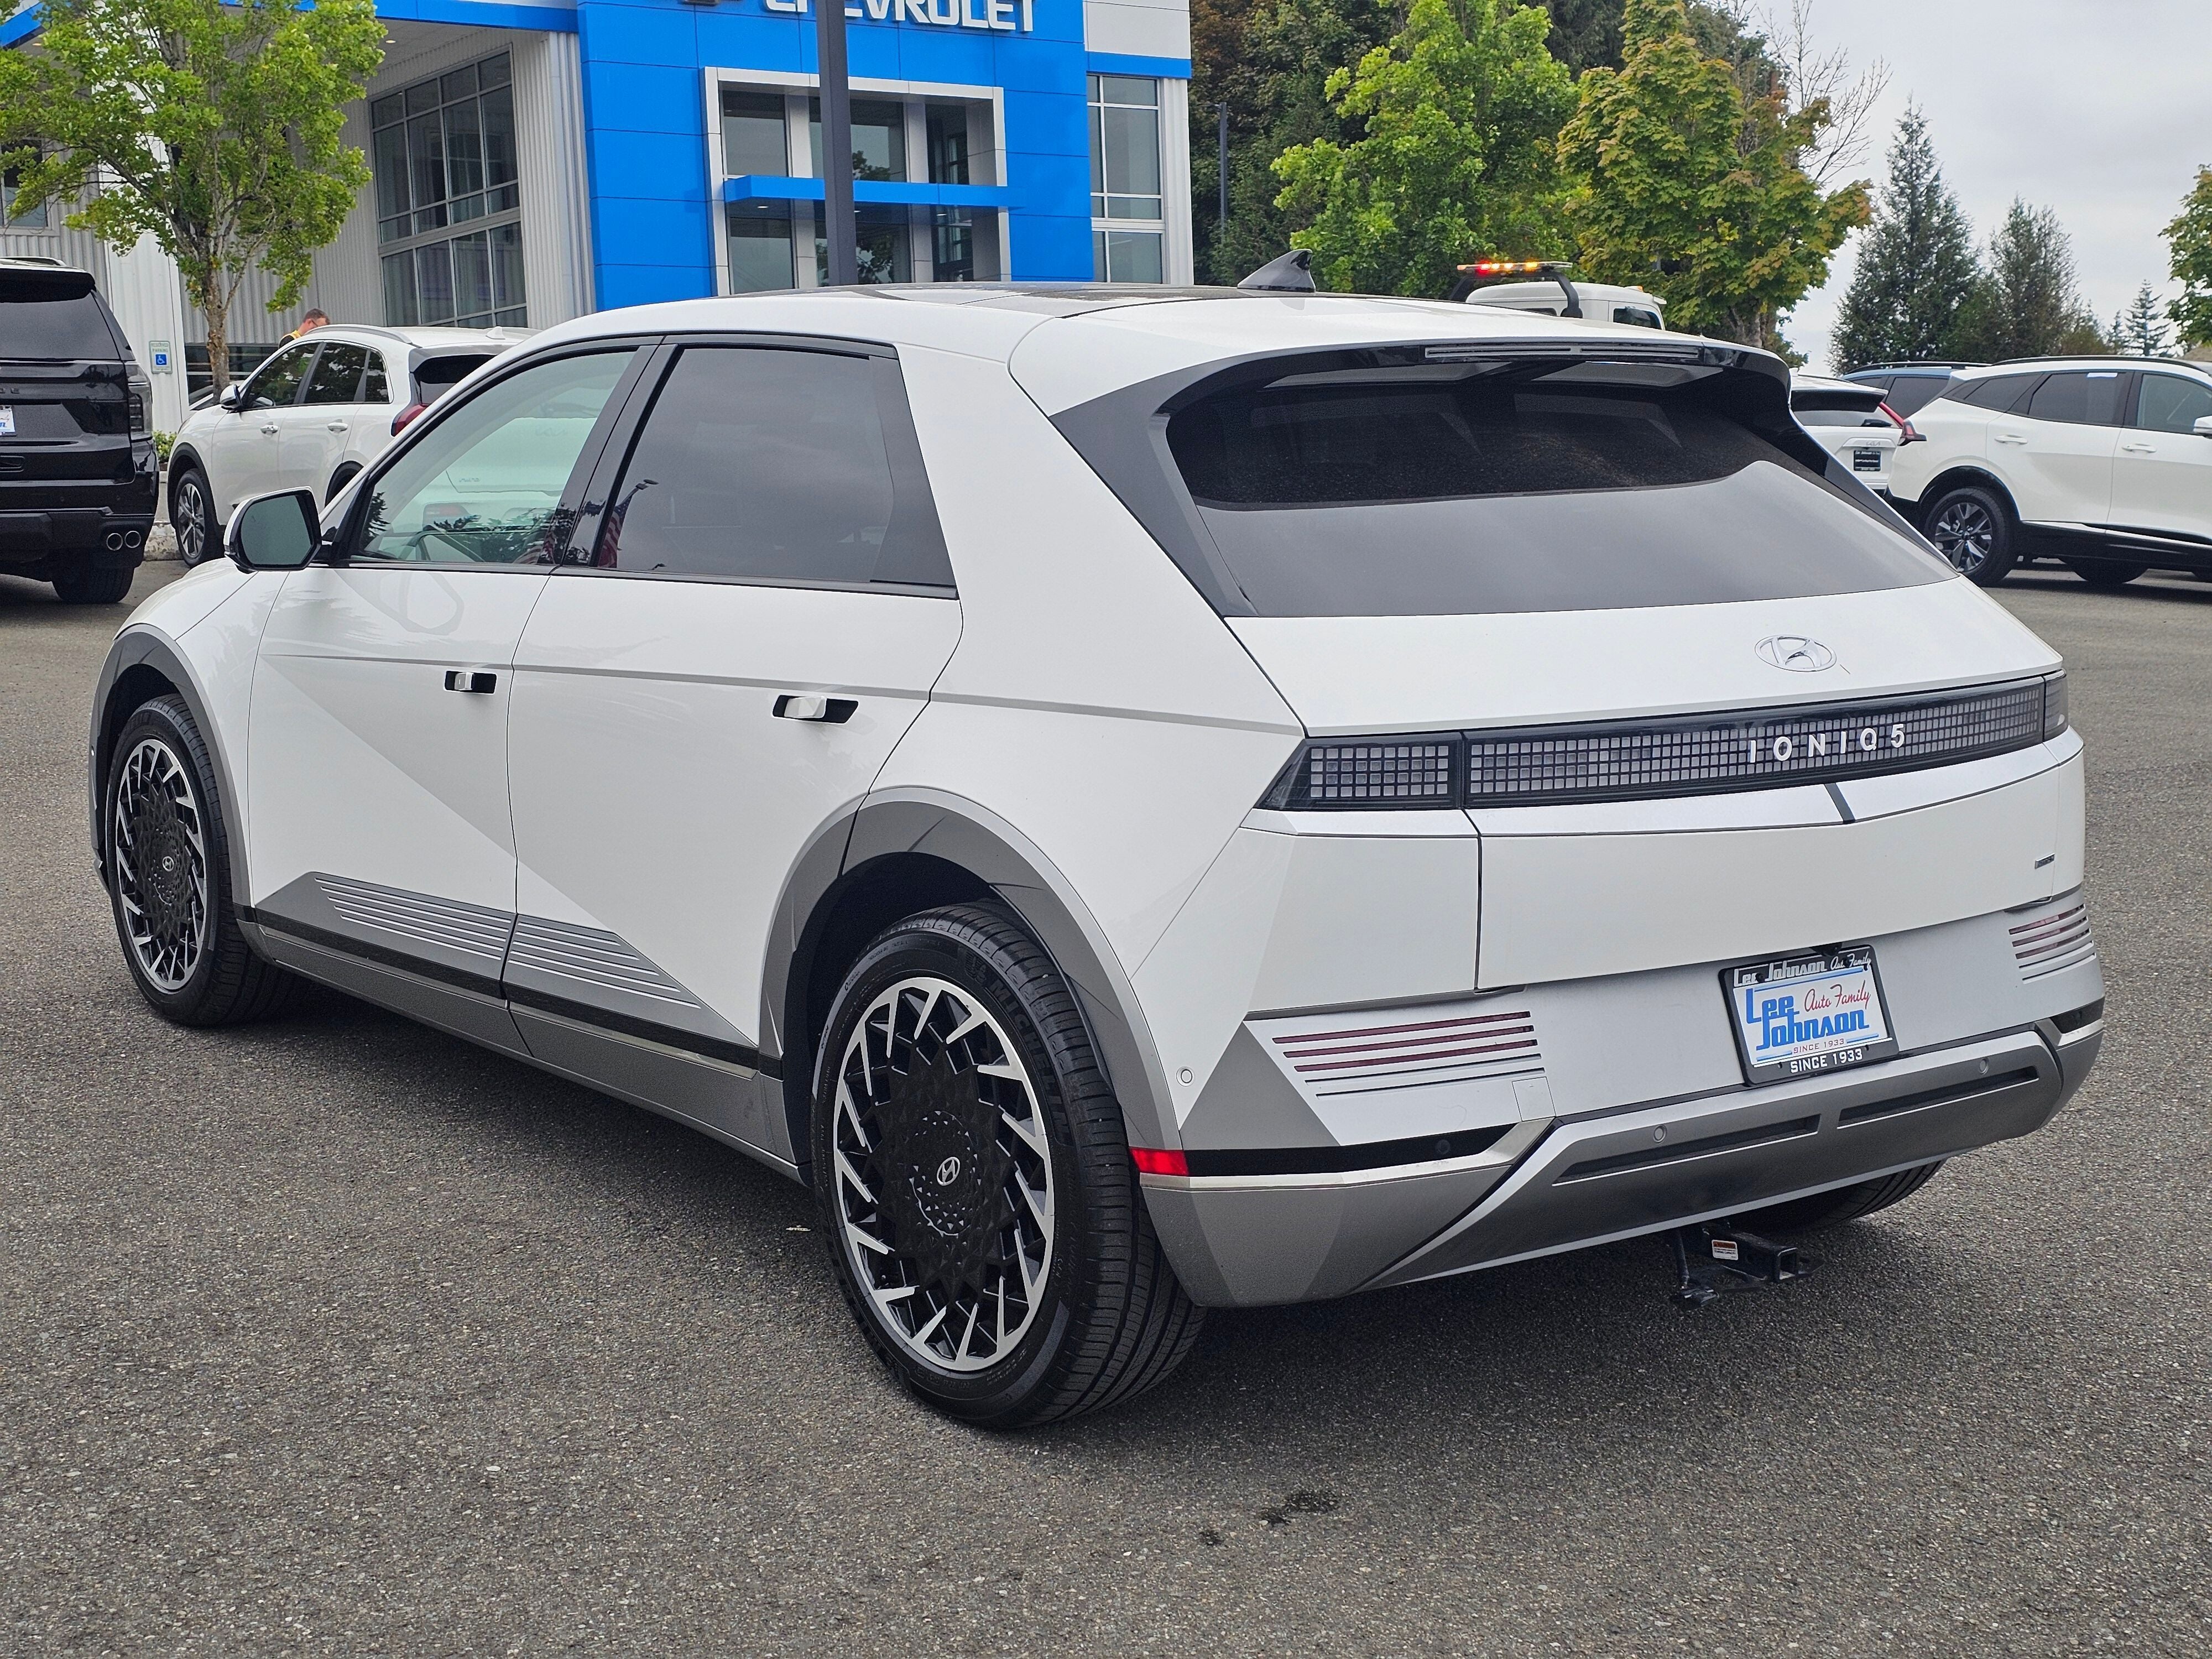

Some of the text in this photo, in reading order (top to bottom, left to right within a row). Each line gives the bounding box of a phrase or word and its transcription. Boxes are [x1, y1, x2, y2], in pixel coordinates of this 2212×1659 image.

[766, 0, 1033, 32] VROLET
[1765, 960, 1827, 982] Johnson
[1830, 956, 1846, 971] Aut
[1746, 988, 1799, 1024] Lee
[1804, 979, 1871, 1012] Auto Family
[1756, 1008, 1870, 1051] Johnson
[1793, 1038, 1844, 1053] SINCE 1933
[1790, 1048, 1863, 1073] SINCE 1933
